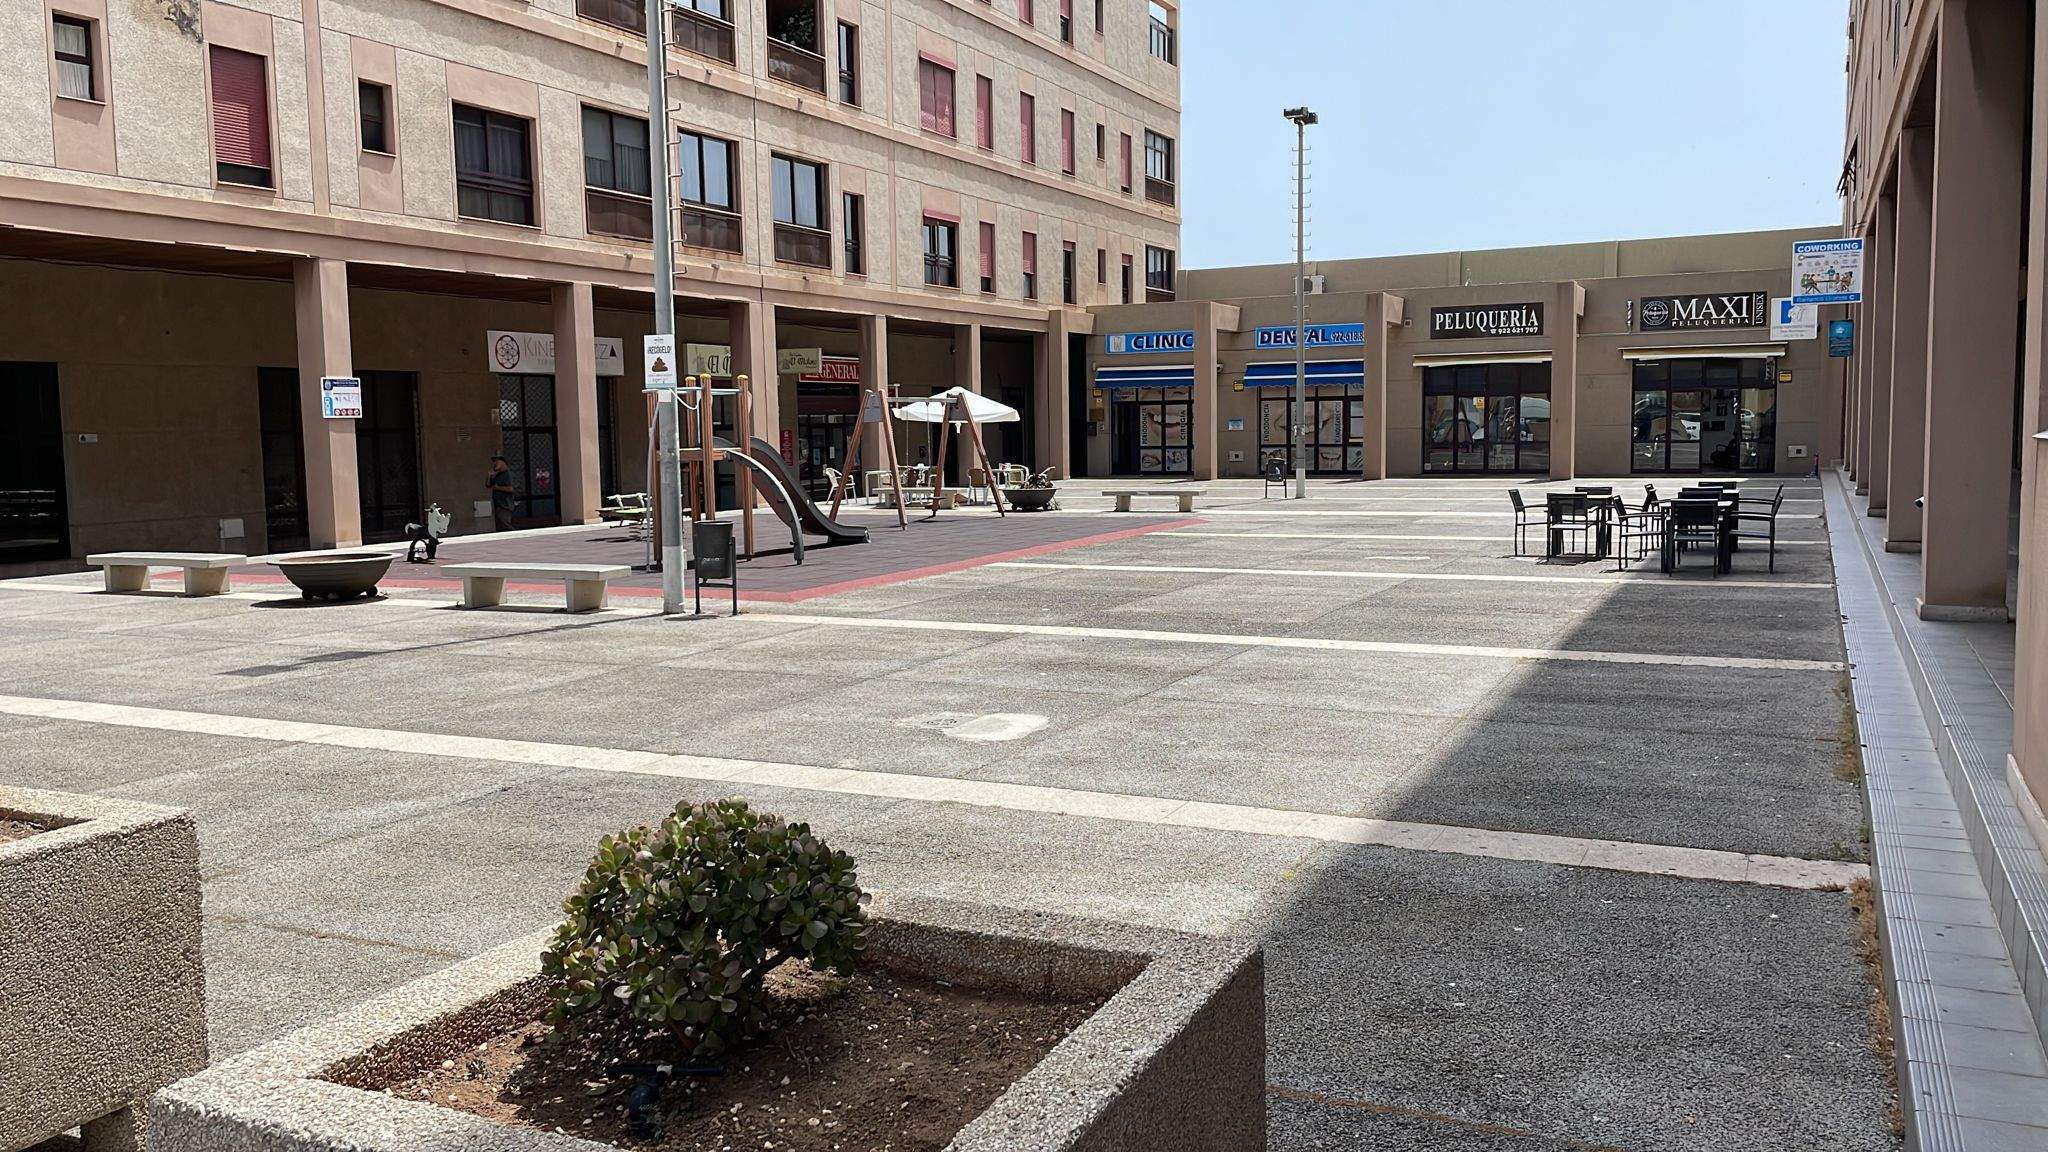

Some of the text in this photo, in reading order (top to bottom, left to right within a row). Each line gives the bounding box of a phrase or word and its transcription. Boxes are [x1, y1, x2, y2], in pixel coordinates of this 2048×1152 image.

[1797, 242, 1859, 253] COWORKING
[1672, 296, 1750, 320] MAXI
[1756, 293, 1765, 325] UNISEX
[1435, 305, 1539, 332] PELUQUERÍA
[1671, 319, 1749, 327] PELUQUERIA
[1131, 333, 1195, 350] CLINIC
[1258, 329, 1329, 346] DENAL
[821, 362, 859, 379] GENERAL
